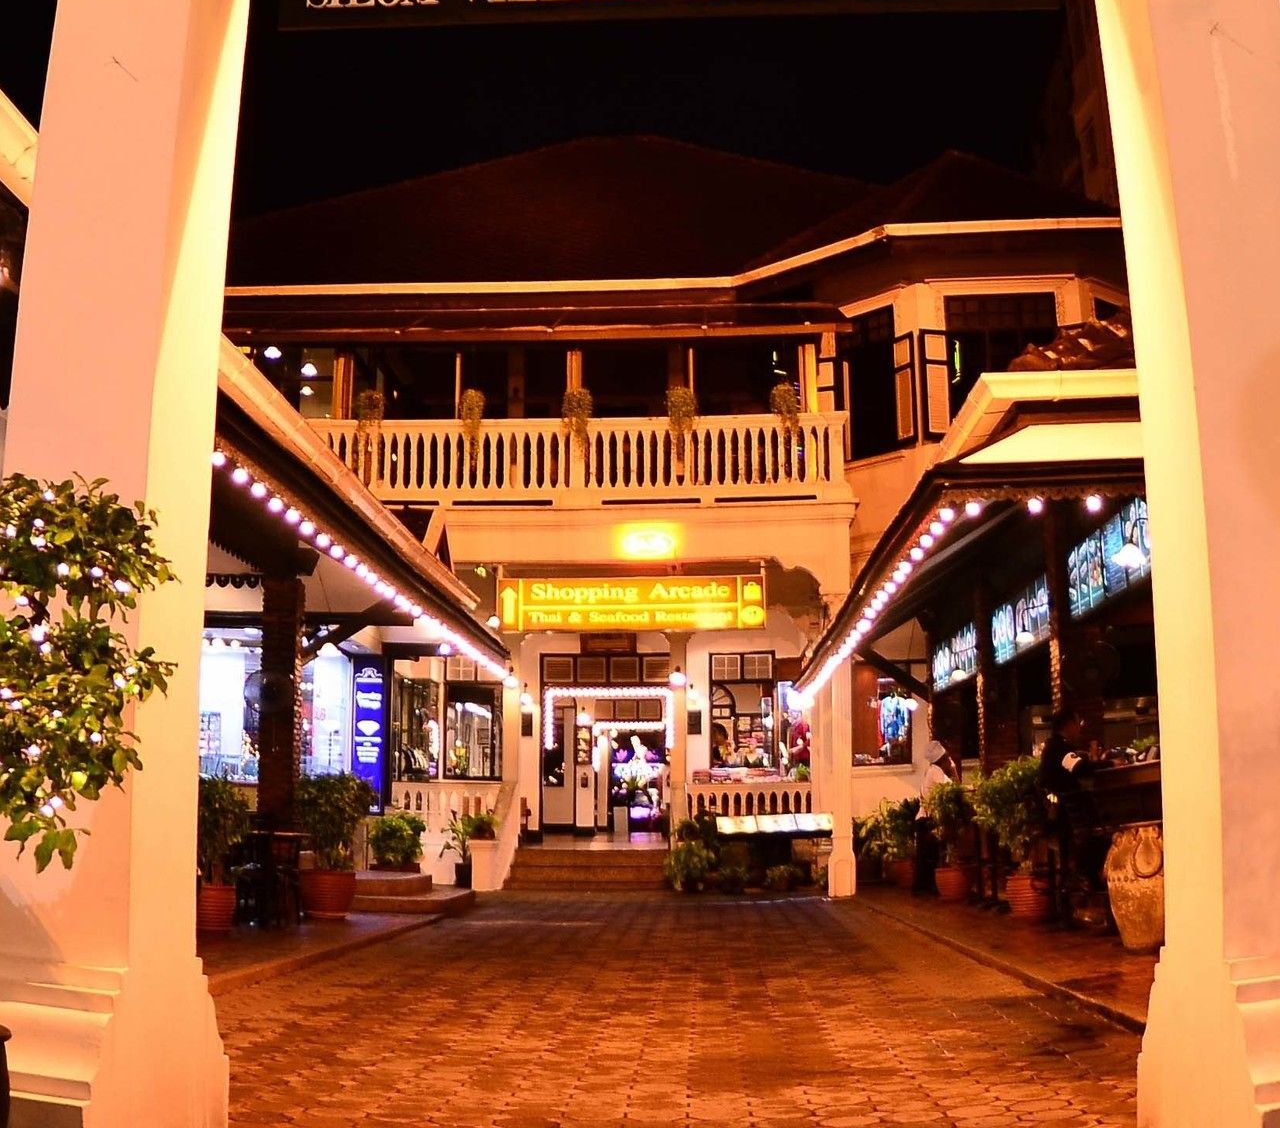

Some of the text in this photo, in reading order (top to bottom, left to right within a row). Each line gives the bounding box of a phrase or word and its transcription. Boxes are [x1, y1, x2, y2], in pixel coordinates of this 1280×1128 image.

[531, 581, 731, 605] Shopping Arcade
[528, 611, 562, 624] Thai
[567, 611, 583, 624] &
[588, 610, 649, 624] Seafood
